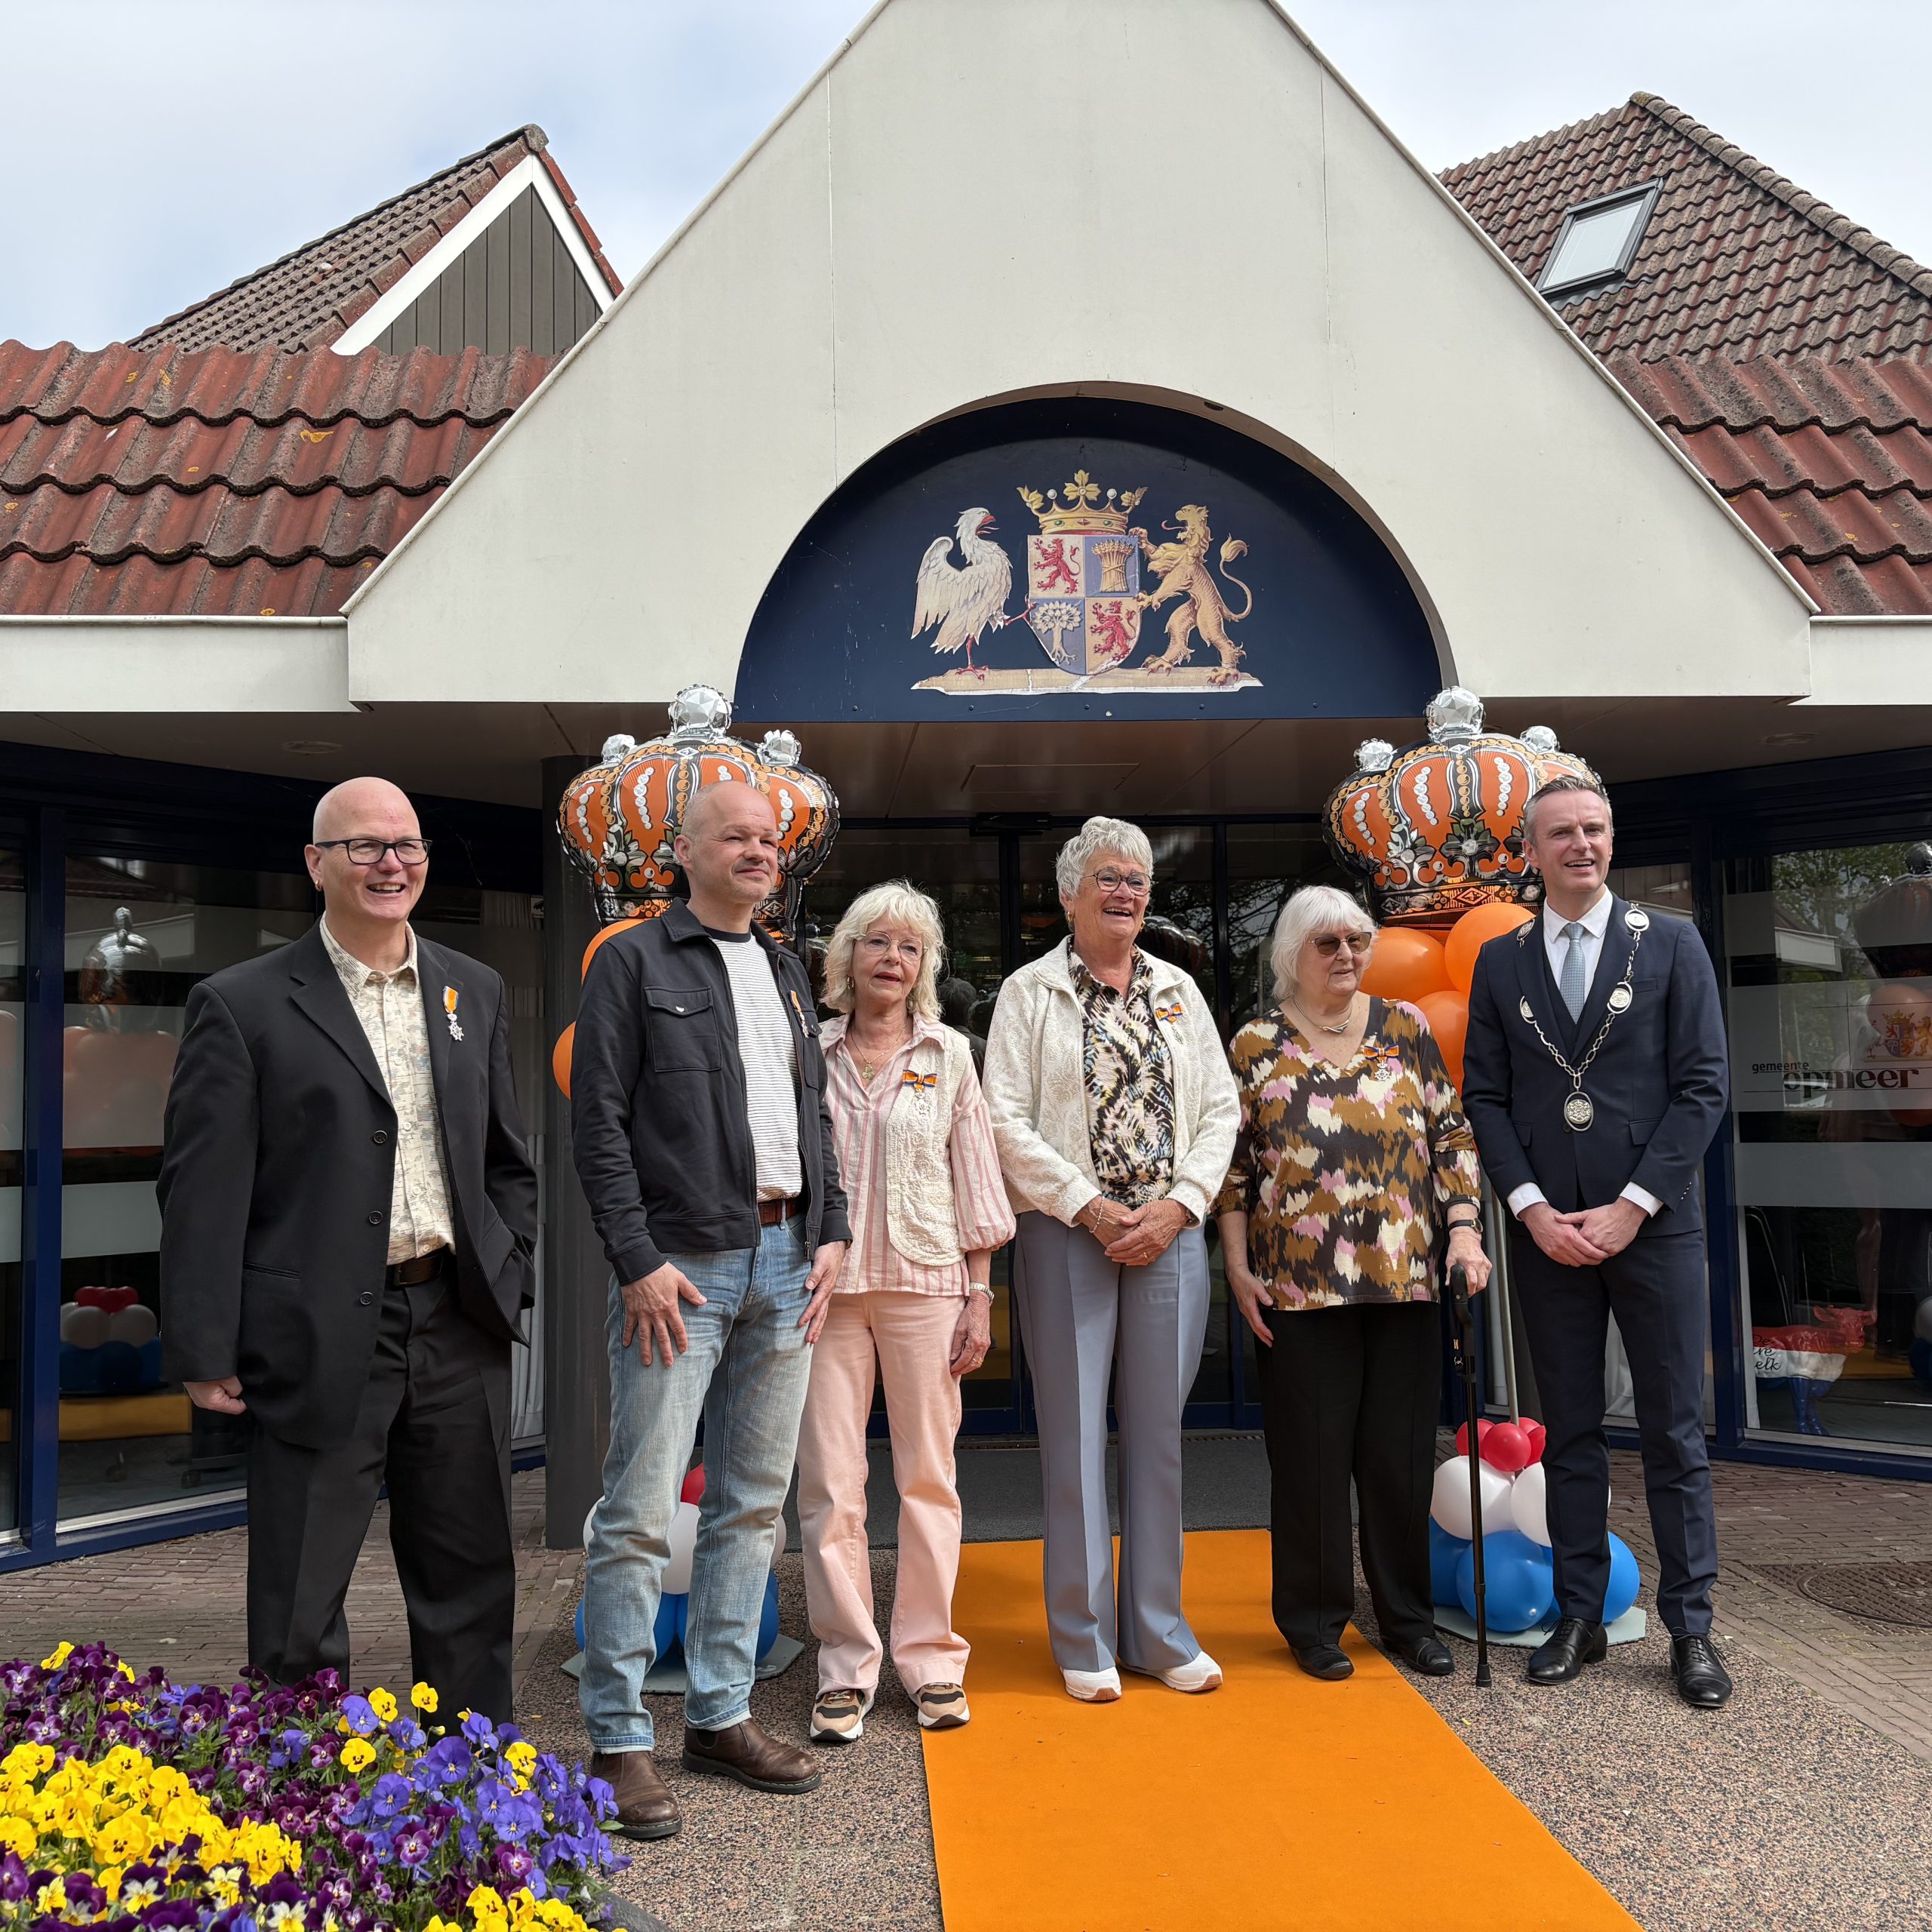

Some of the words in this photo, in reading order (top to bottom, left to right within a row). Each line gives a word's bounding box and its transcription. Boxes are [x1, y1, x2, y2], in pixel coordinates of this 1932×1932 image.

[1752, 1060, 1810, 1074] gemeente
[1783, 1069, 1919, 1098] opmeer
[1754, 1358, 1781, 1371] elk
